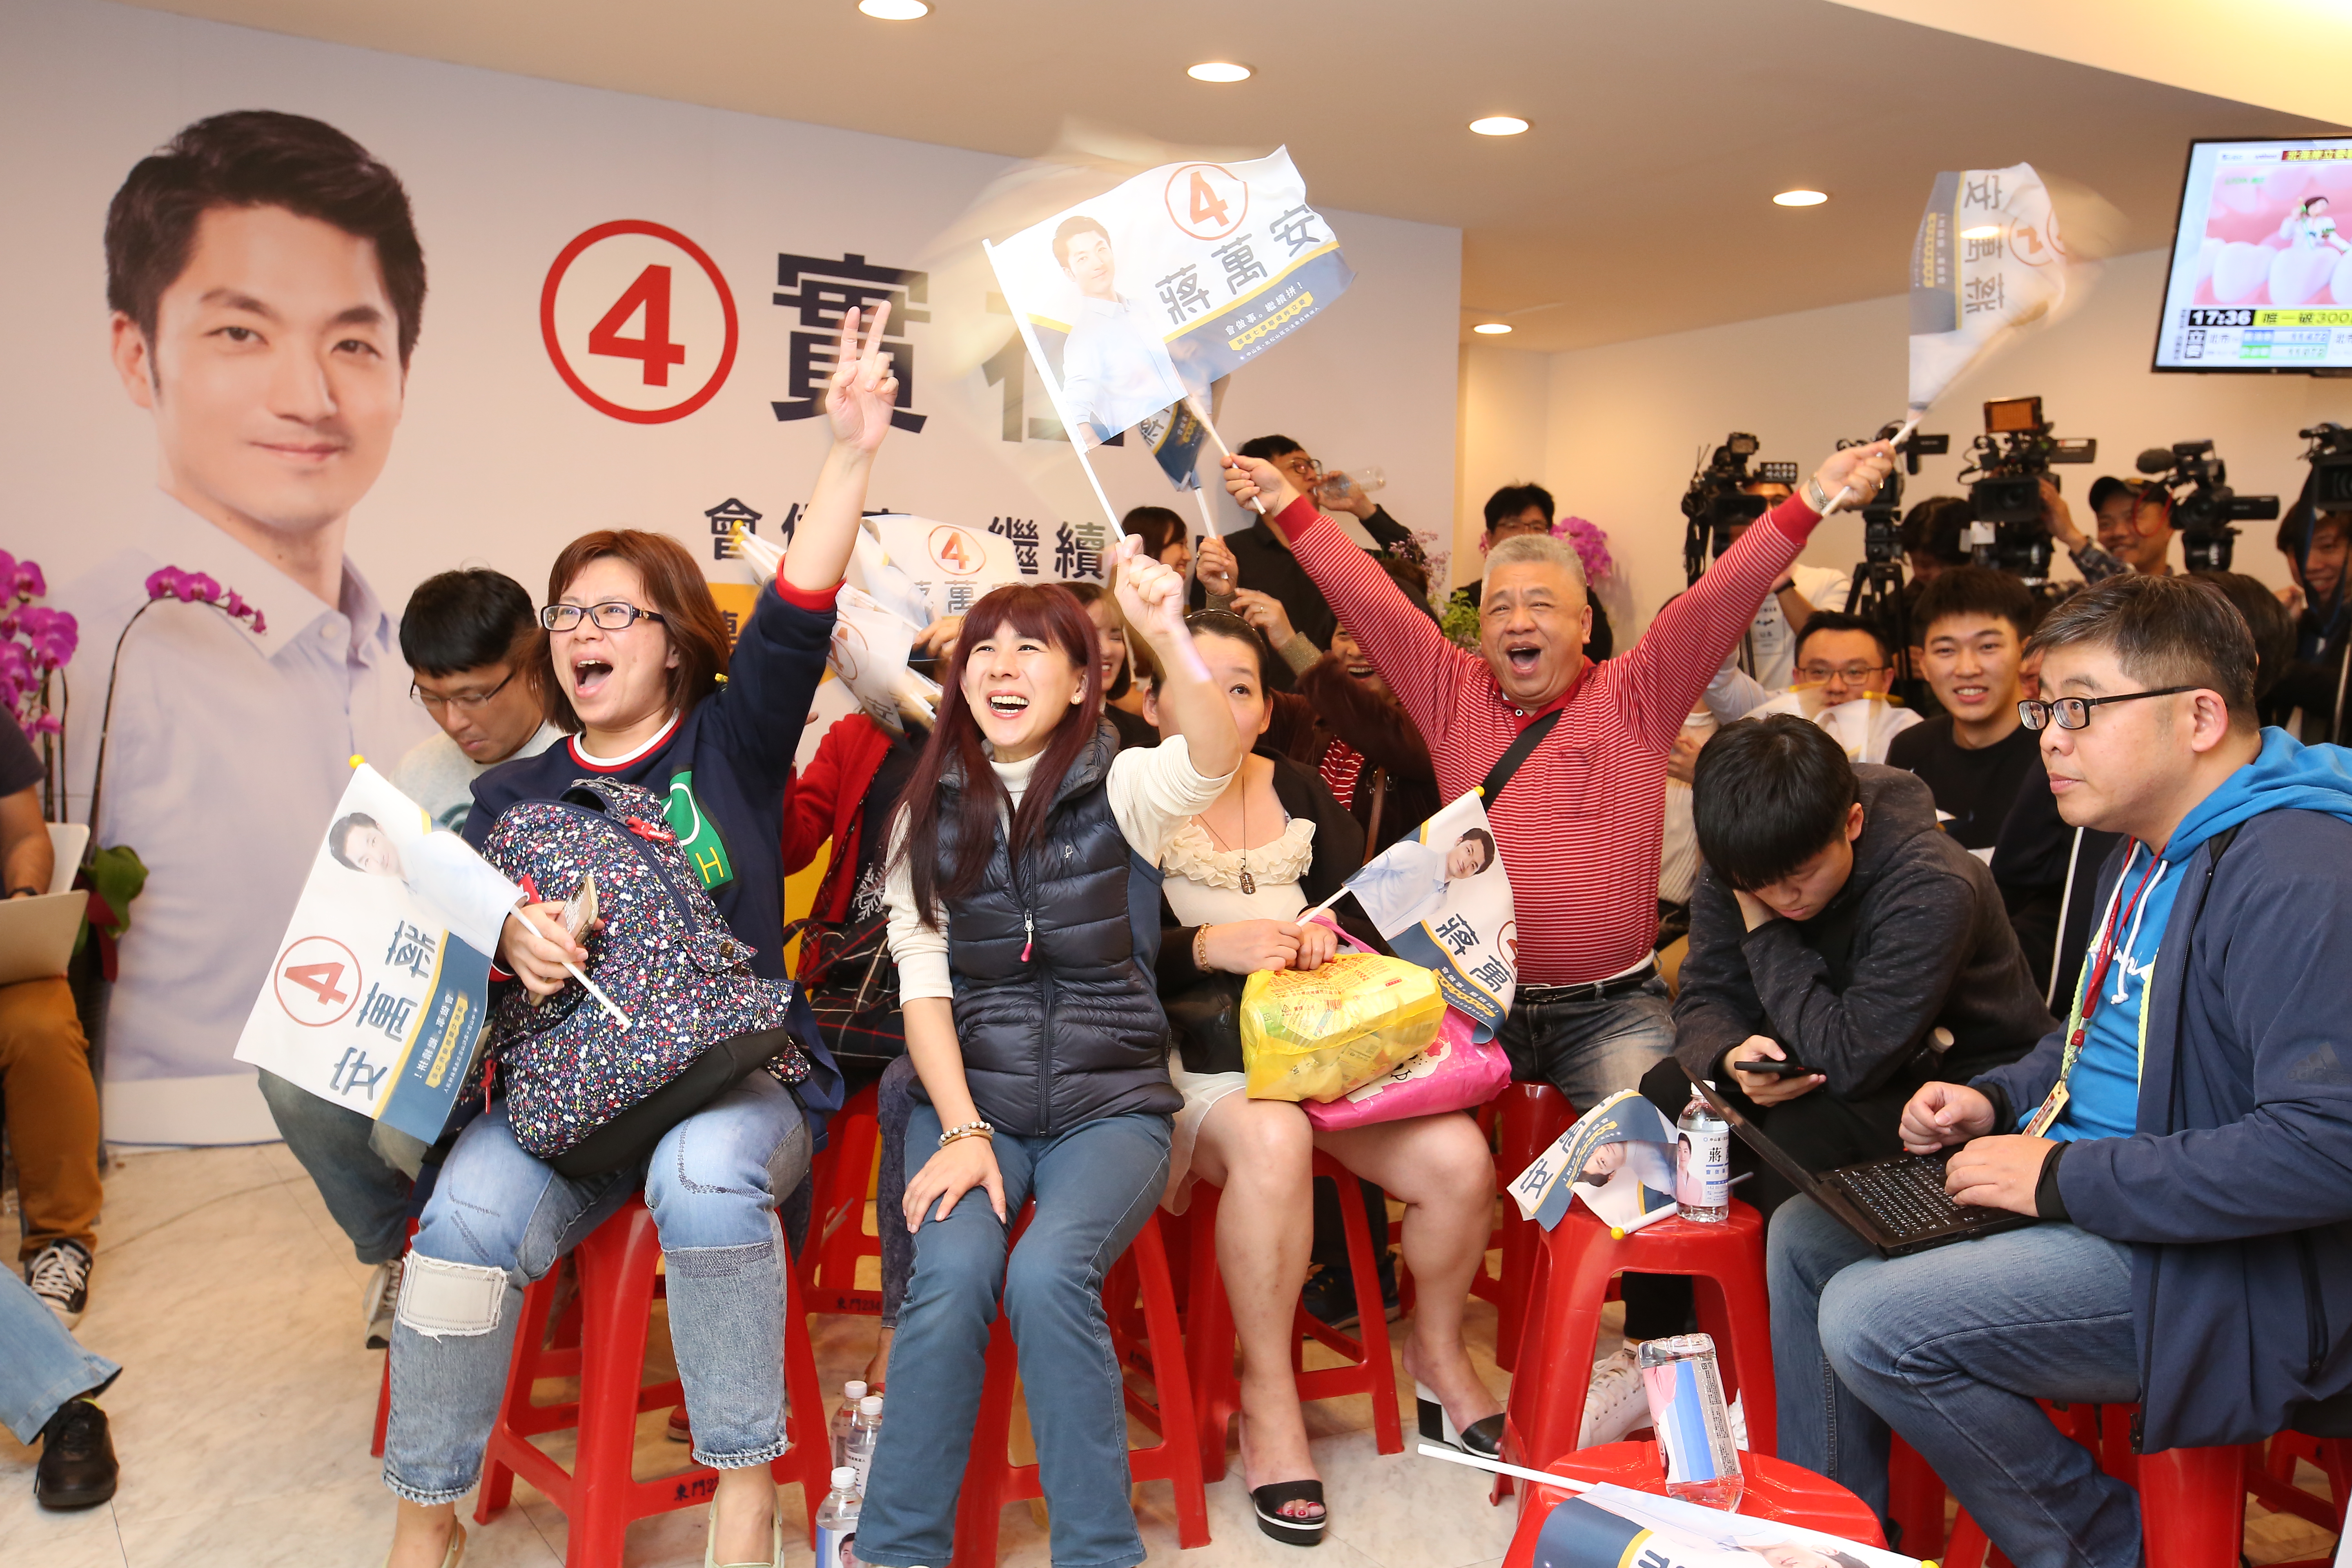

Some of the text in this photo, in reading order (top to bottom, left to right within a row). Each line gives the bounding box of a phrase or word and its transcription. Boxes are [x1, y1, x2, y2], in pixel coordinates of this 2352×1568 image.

[1189, 171, 1229, 227] 4
[1155, 204, 1321, 325] 蔣萬安
[588, 264, 686, 387] 4
[2192, 310, 2252, 325] 17:36
[941, 532, 970, 570] 4
